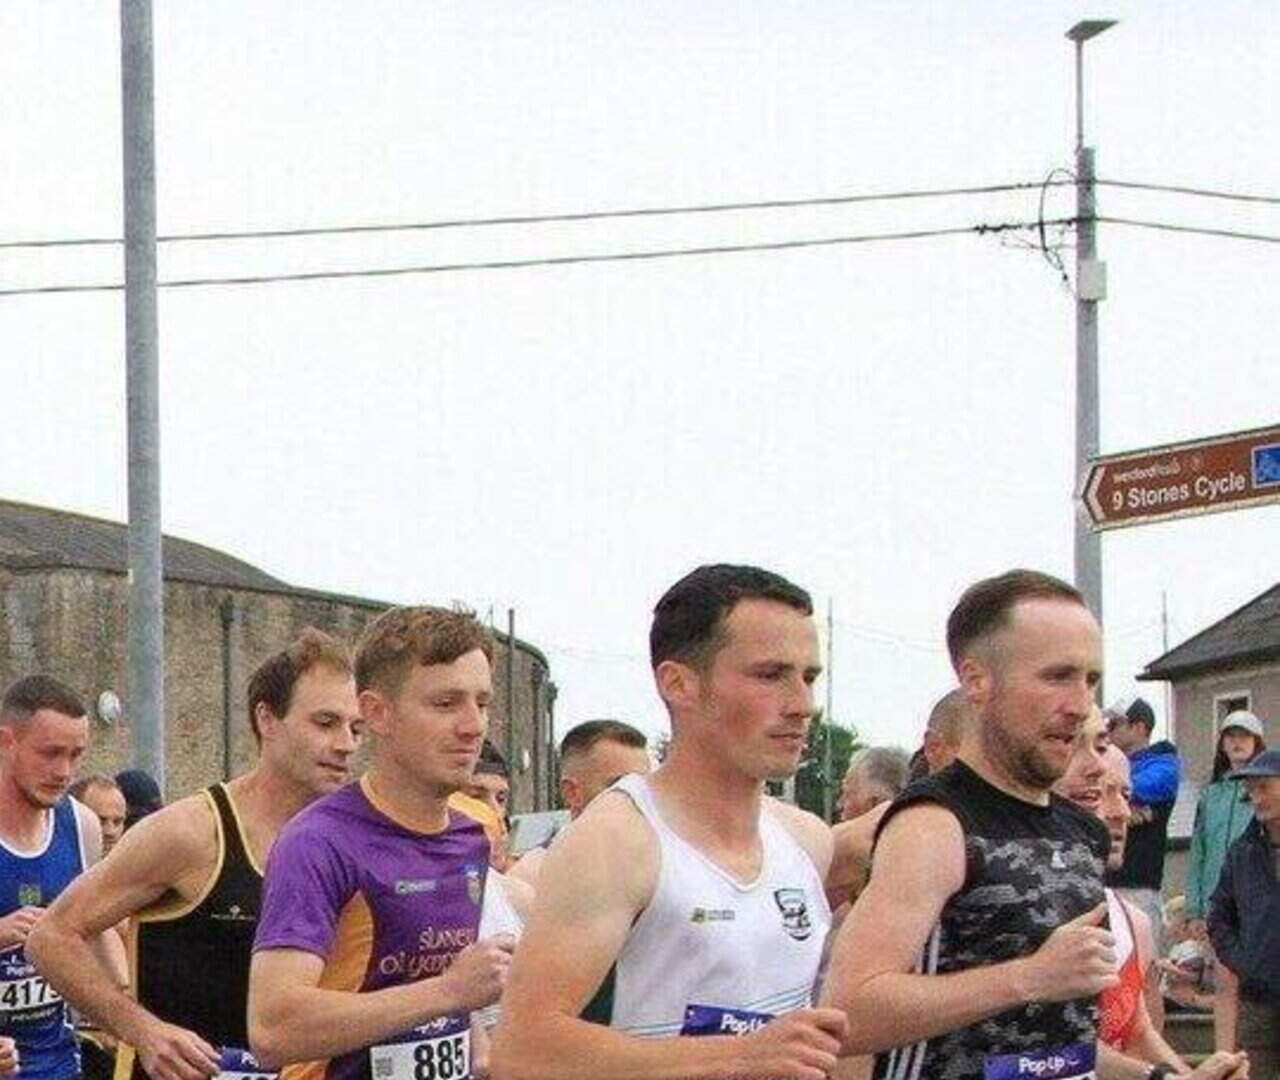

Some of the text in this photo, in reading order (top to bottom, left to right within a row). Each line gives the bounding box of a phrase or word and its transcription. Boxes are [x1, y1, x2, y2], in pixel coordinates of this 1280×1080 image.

[1112, 471, 1246, 511] 9 Stones Cycle
[1, 979, 60, 1008] 417
[720, 1014, 746, 1036] Pop
[1019, 1055, 1065, 1077] Pop Up
